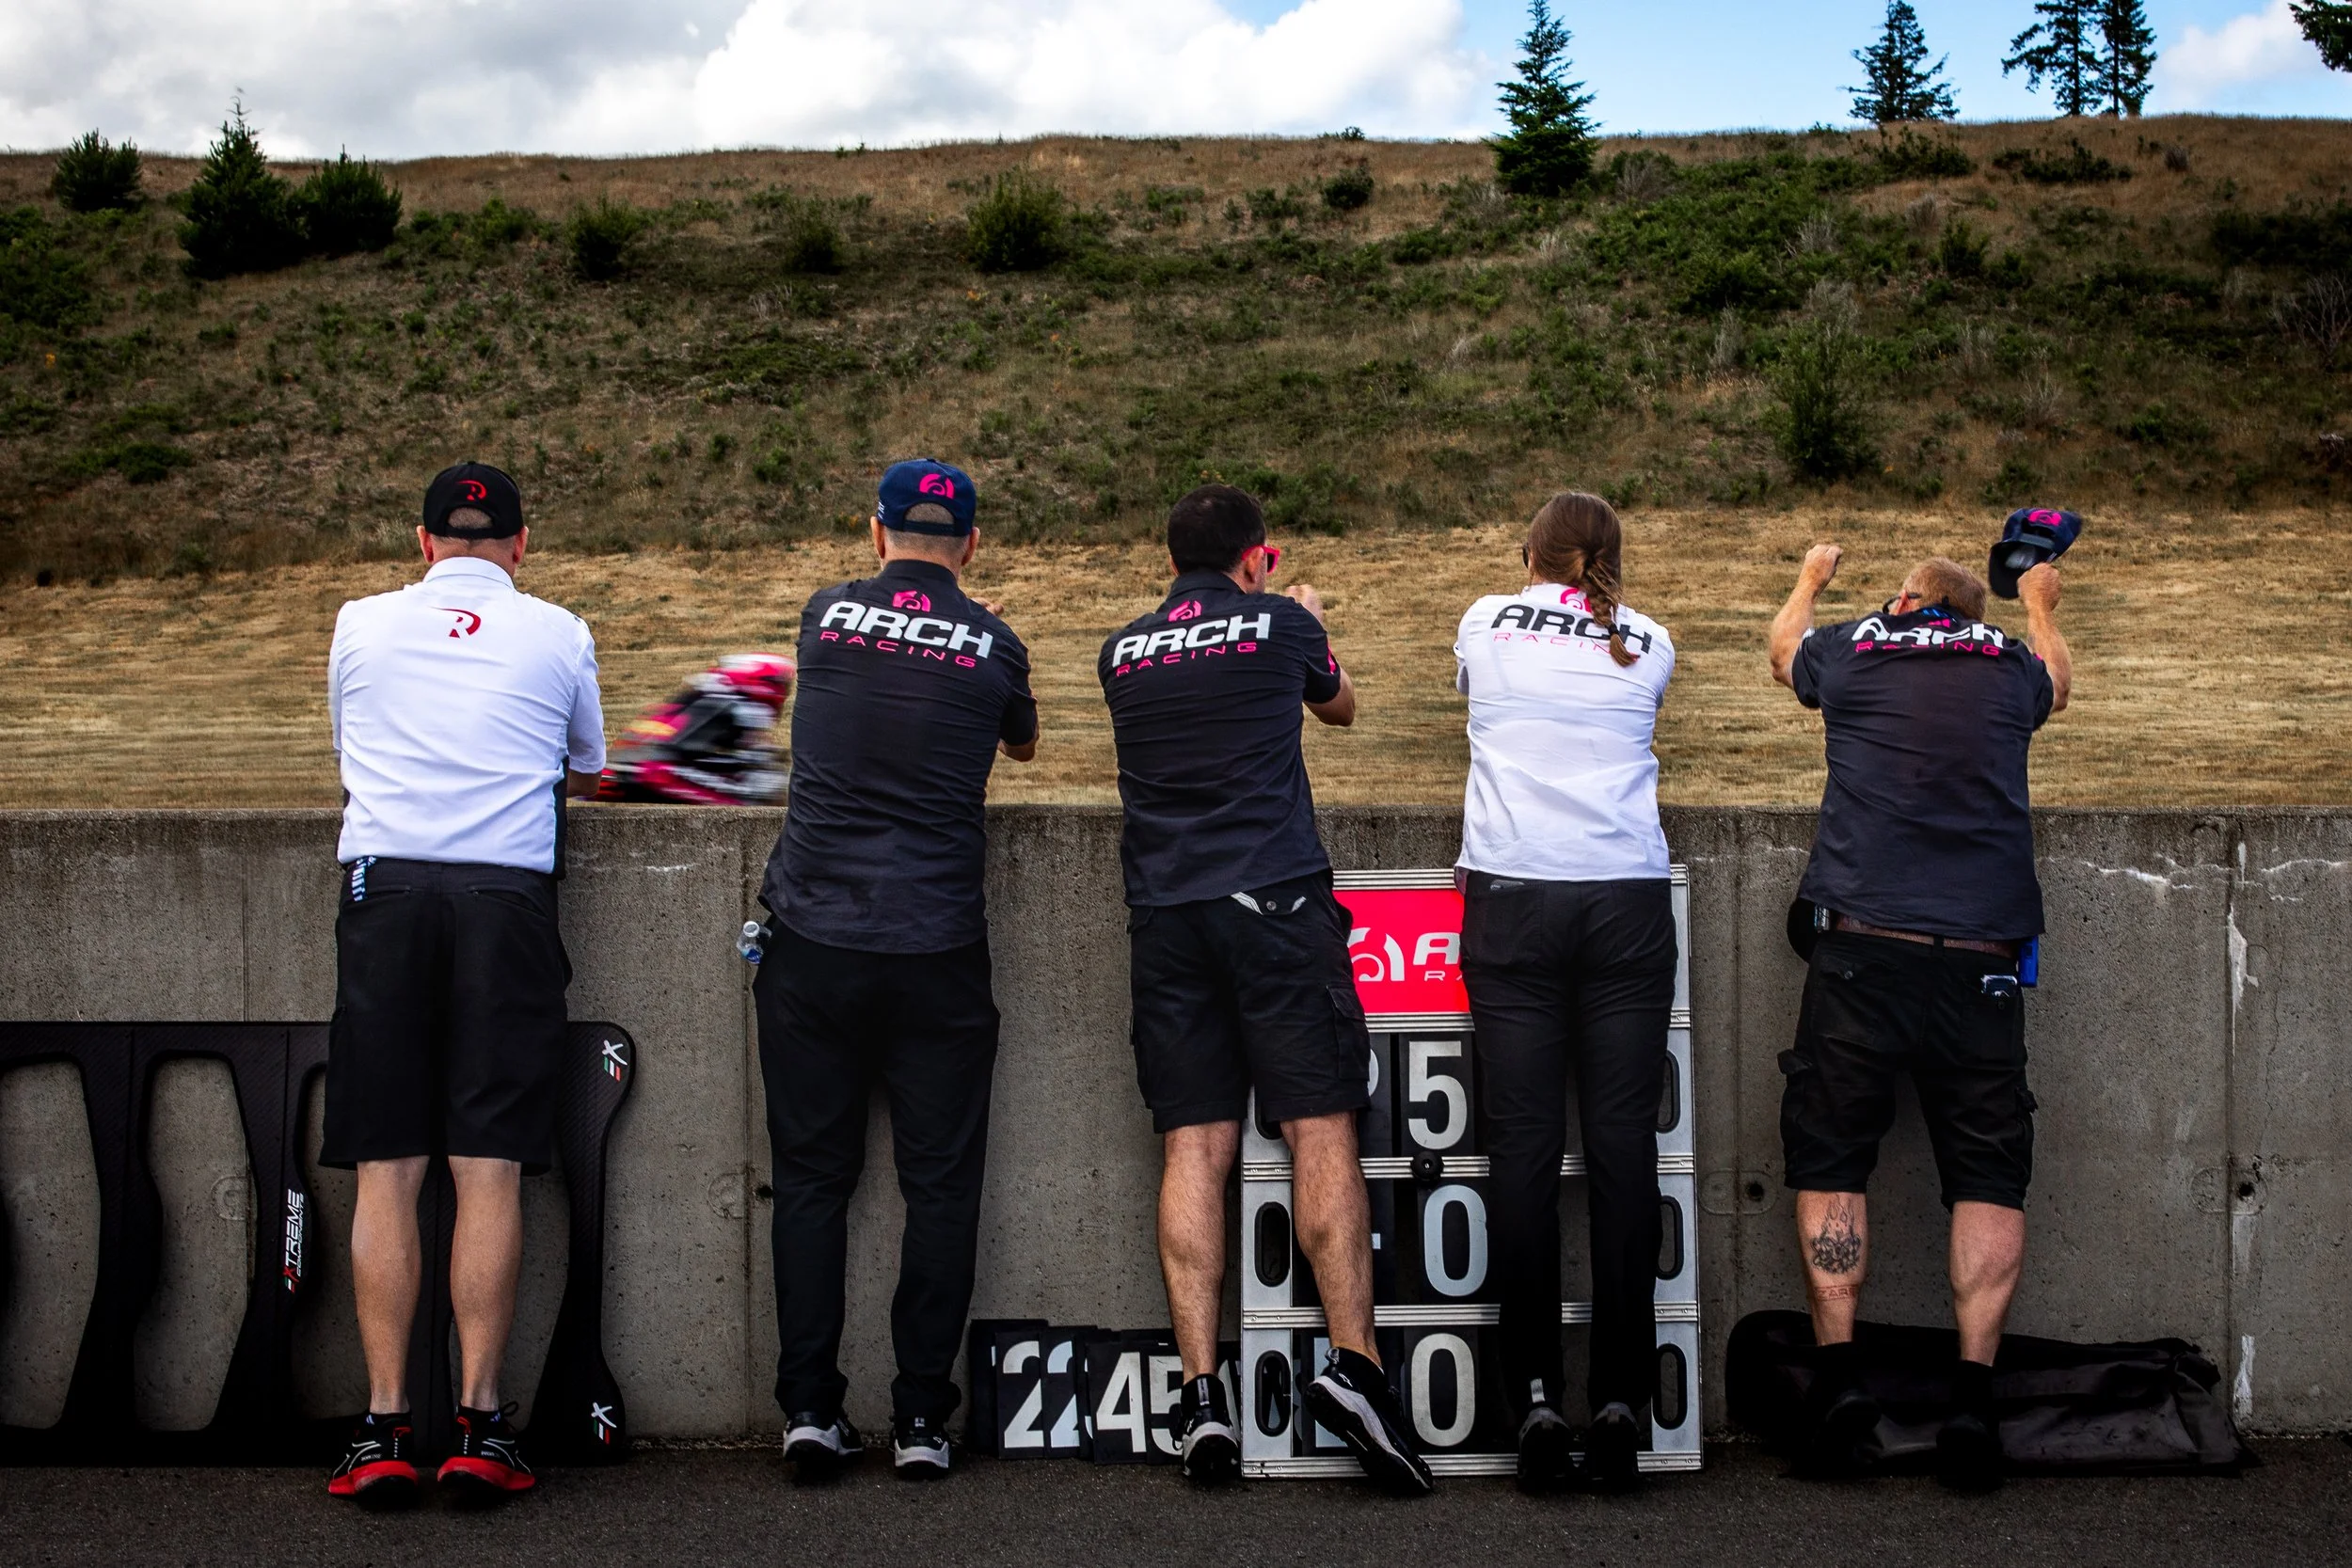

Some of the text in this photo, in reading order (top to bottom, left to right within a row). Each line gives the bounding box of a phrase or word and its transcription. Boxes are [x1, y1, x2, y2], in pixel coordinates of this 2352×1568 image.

[819, 601, 993, 658] ARCH
[820, 631, 977, 668] RACING
[1113, 613, 1271, 668] ARCH
[1491, 604, 1652, 654] ARCH
[1493, 632, 1640, 661] RACIN
[1851, 617, 2004, 649] ARCH
[1116, 641, 1257, 676] RACING
[1407, 1040, 1468, 1149] 5
[1423, 1184, 1488, 1297] 0
[1411, 1333, 1476, 1447] 0
